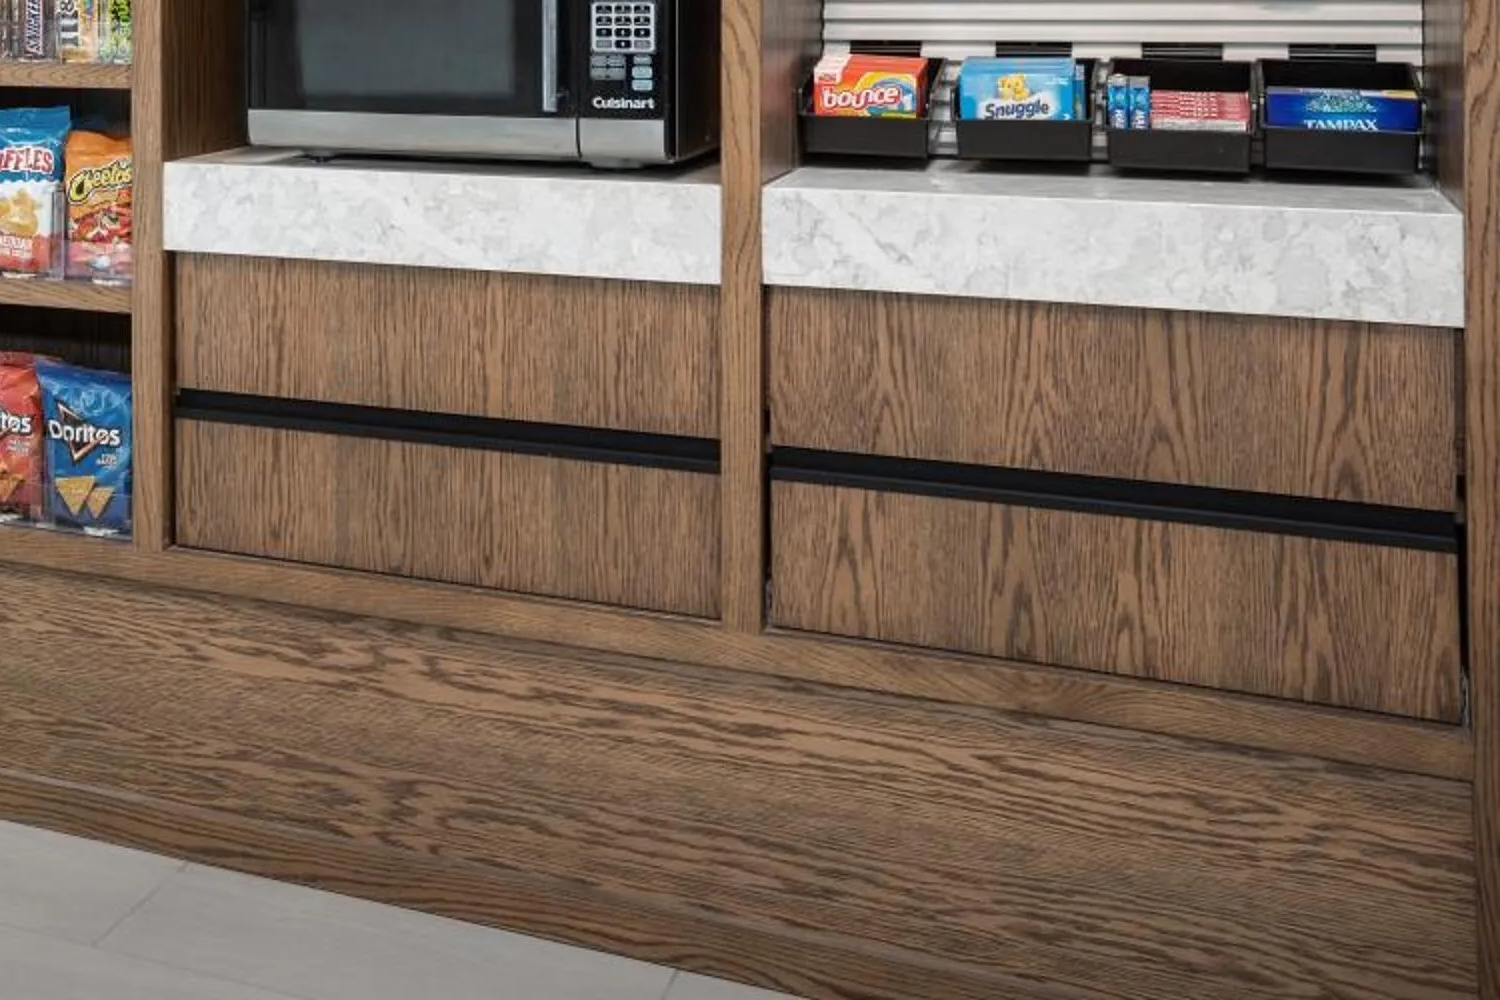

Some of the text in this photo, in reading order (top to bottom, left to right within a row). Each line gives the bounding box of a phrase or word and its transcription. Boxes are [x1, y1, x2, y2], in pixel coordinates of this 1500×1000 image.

[592, 96, 655, 109] Cuisinart
[822, 86, 900, 109] bounce
[984, 99, 1050, 120] Snuggle
[1304, 118, 1379, 131] TAMPAX
[68, 158, 133, 202] Cheetos
[49, 420, 121, 446] Doritos
